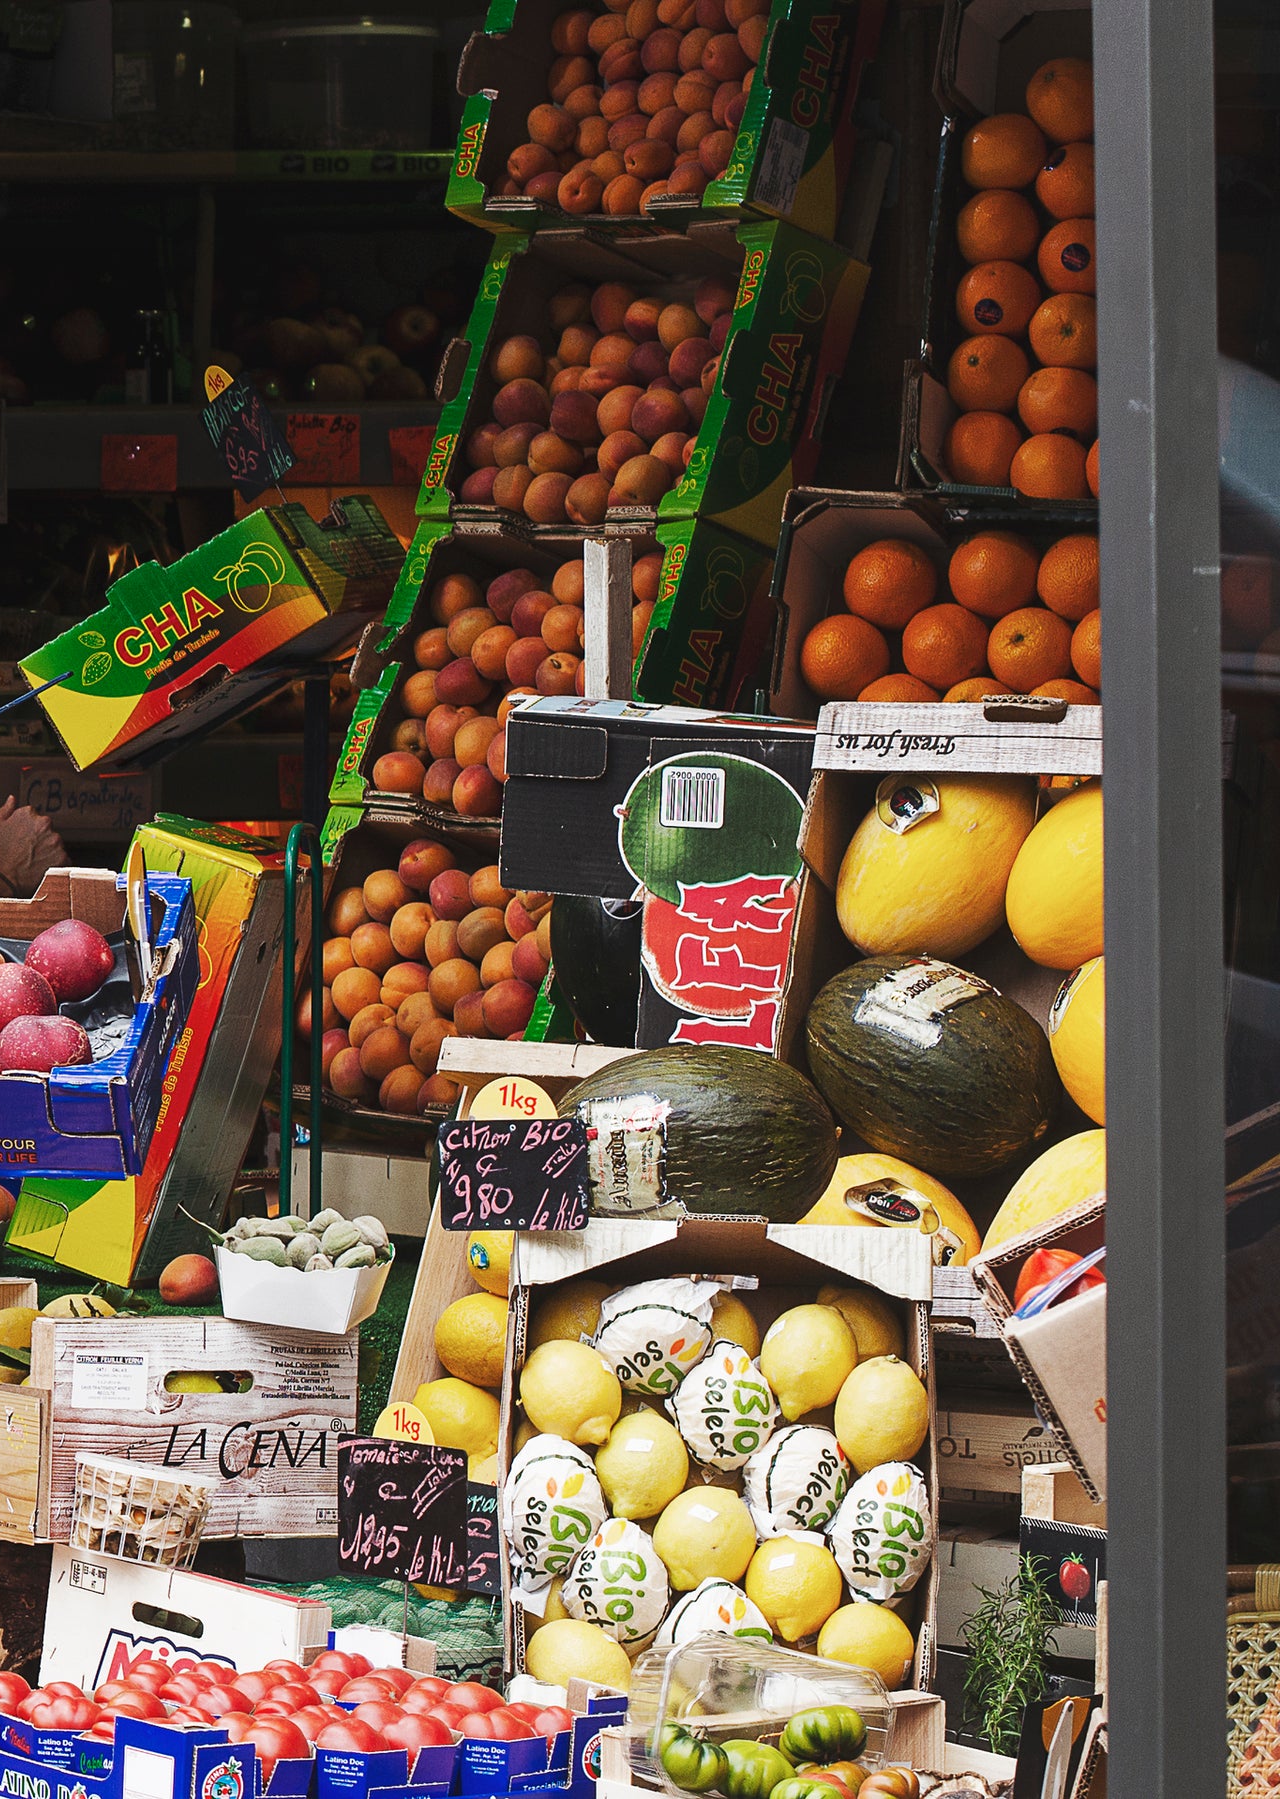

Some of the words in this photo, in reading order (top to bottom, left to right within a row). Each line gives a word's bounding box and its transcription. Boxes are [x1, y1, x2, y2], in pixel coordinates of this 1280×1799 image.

[312, 157, 349, 173] BIO
[403, 157, 440, 173] BIO
[455, 121, 481, 179] CHA
[738, 250, 764, 309] CHA
[208, 372, 226, 394] 1kg
[747, 331, 804, 447] CHA
[425, 433, 452, 492] CHA
[660, 543, 687, 603] CHA
[113, 586, 225, 669] CHA
[186, 627, 221, 655] Tunisie
[345, 717, 373, 773] CHA
[836, 733, 856, 748] us
[860, 733, 894, 756] for
[897, 731, 957, 755] Fresh
[499, 1083, 538, 1113] 1kg
[519, 1119, 573, 1152] Bio
[7, 1152, 38, 1165] LIFE
[452, 1175, 514, 1226] 9,80
[76, 1356, 98, 1365] CITRON
[100, 1356, 122, 1365] FEUILLE
[123, 1356, 144, 1365] VERNA
[393, 1408, 421, 1441] 1kg
[732, 1380, 770, 1455] Bio
[162, 1423, 207, 1467] LA
[218, 1421, 328, 1480] CEÑA
[545, 1504, 593, 1577] Bio
[878, 1502, 925, 1579] Bio
[600, 1550, 648, 1622] Bio
[37, 1737, 61, 1747] Latino
[466, 1744, 488, 1754] Latino
[489, 1746, 506, 1755] Doc
[324, 1755, 347, 1765] Latino
[348, 1758, 365, 1767] Doc
